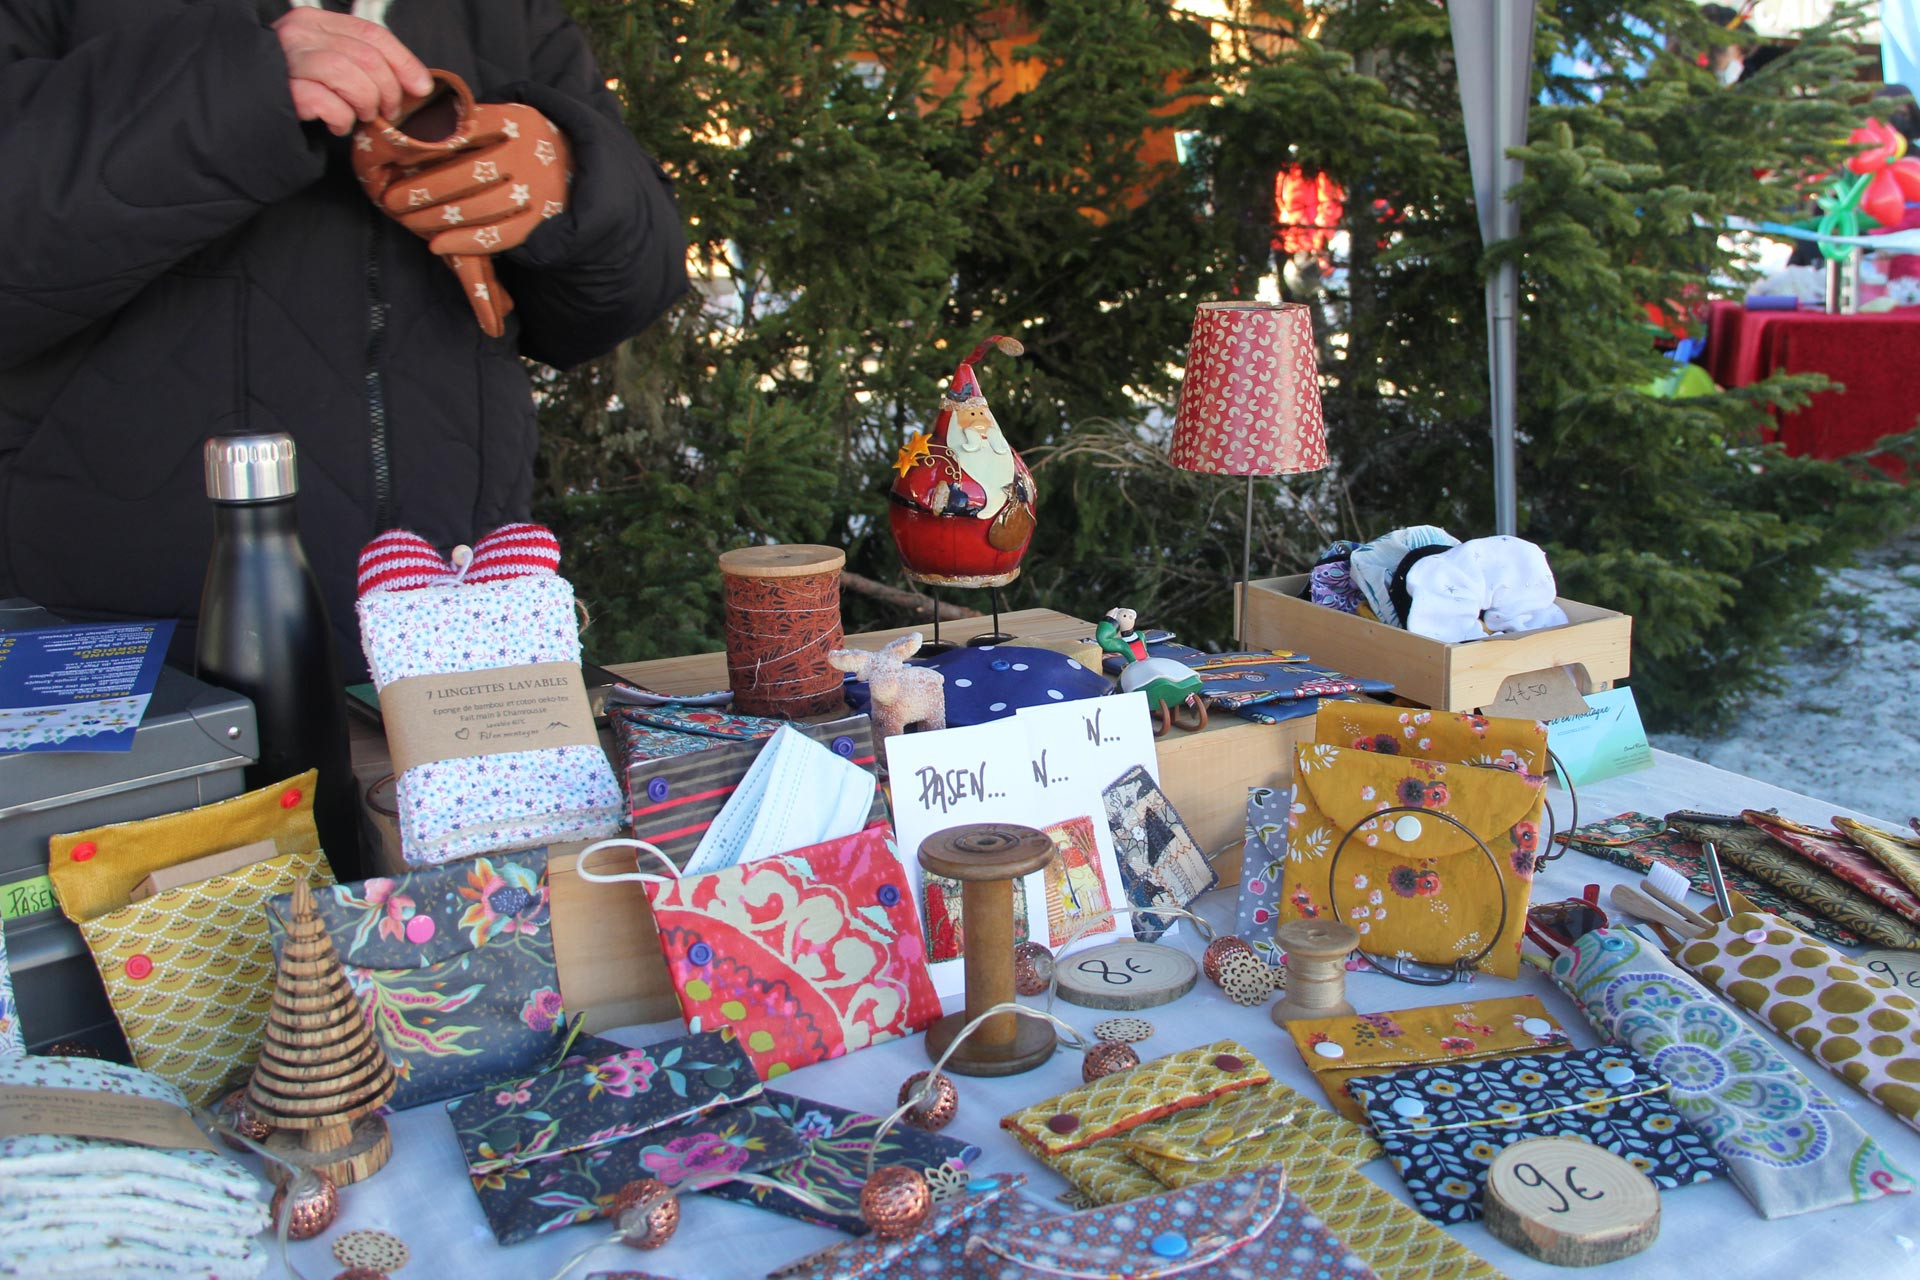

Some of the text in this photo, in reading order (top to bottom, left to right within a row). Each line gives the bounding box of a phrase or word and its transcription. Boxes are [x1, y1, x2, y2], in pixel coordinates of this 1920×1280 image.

[426, 677, 569, 700] 7 LINGETTES LAVABLES
[463, 704, 472, 712] de
[474, 701, 504, 711] bambou
[516, 698, 537, 706] coton
[460, 714, 475, 722] Fait
[476, 712, 495, 720] main
[502, 707, 547, 717] Chamrousse
